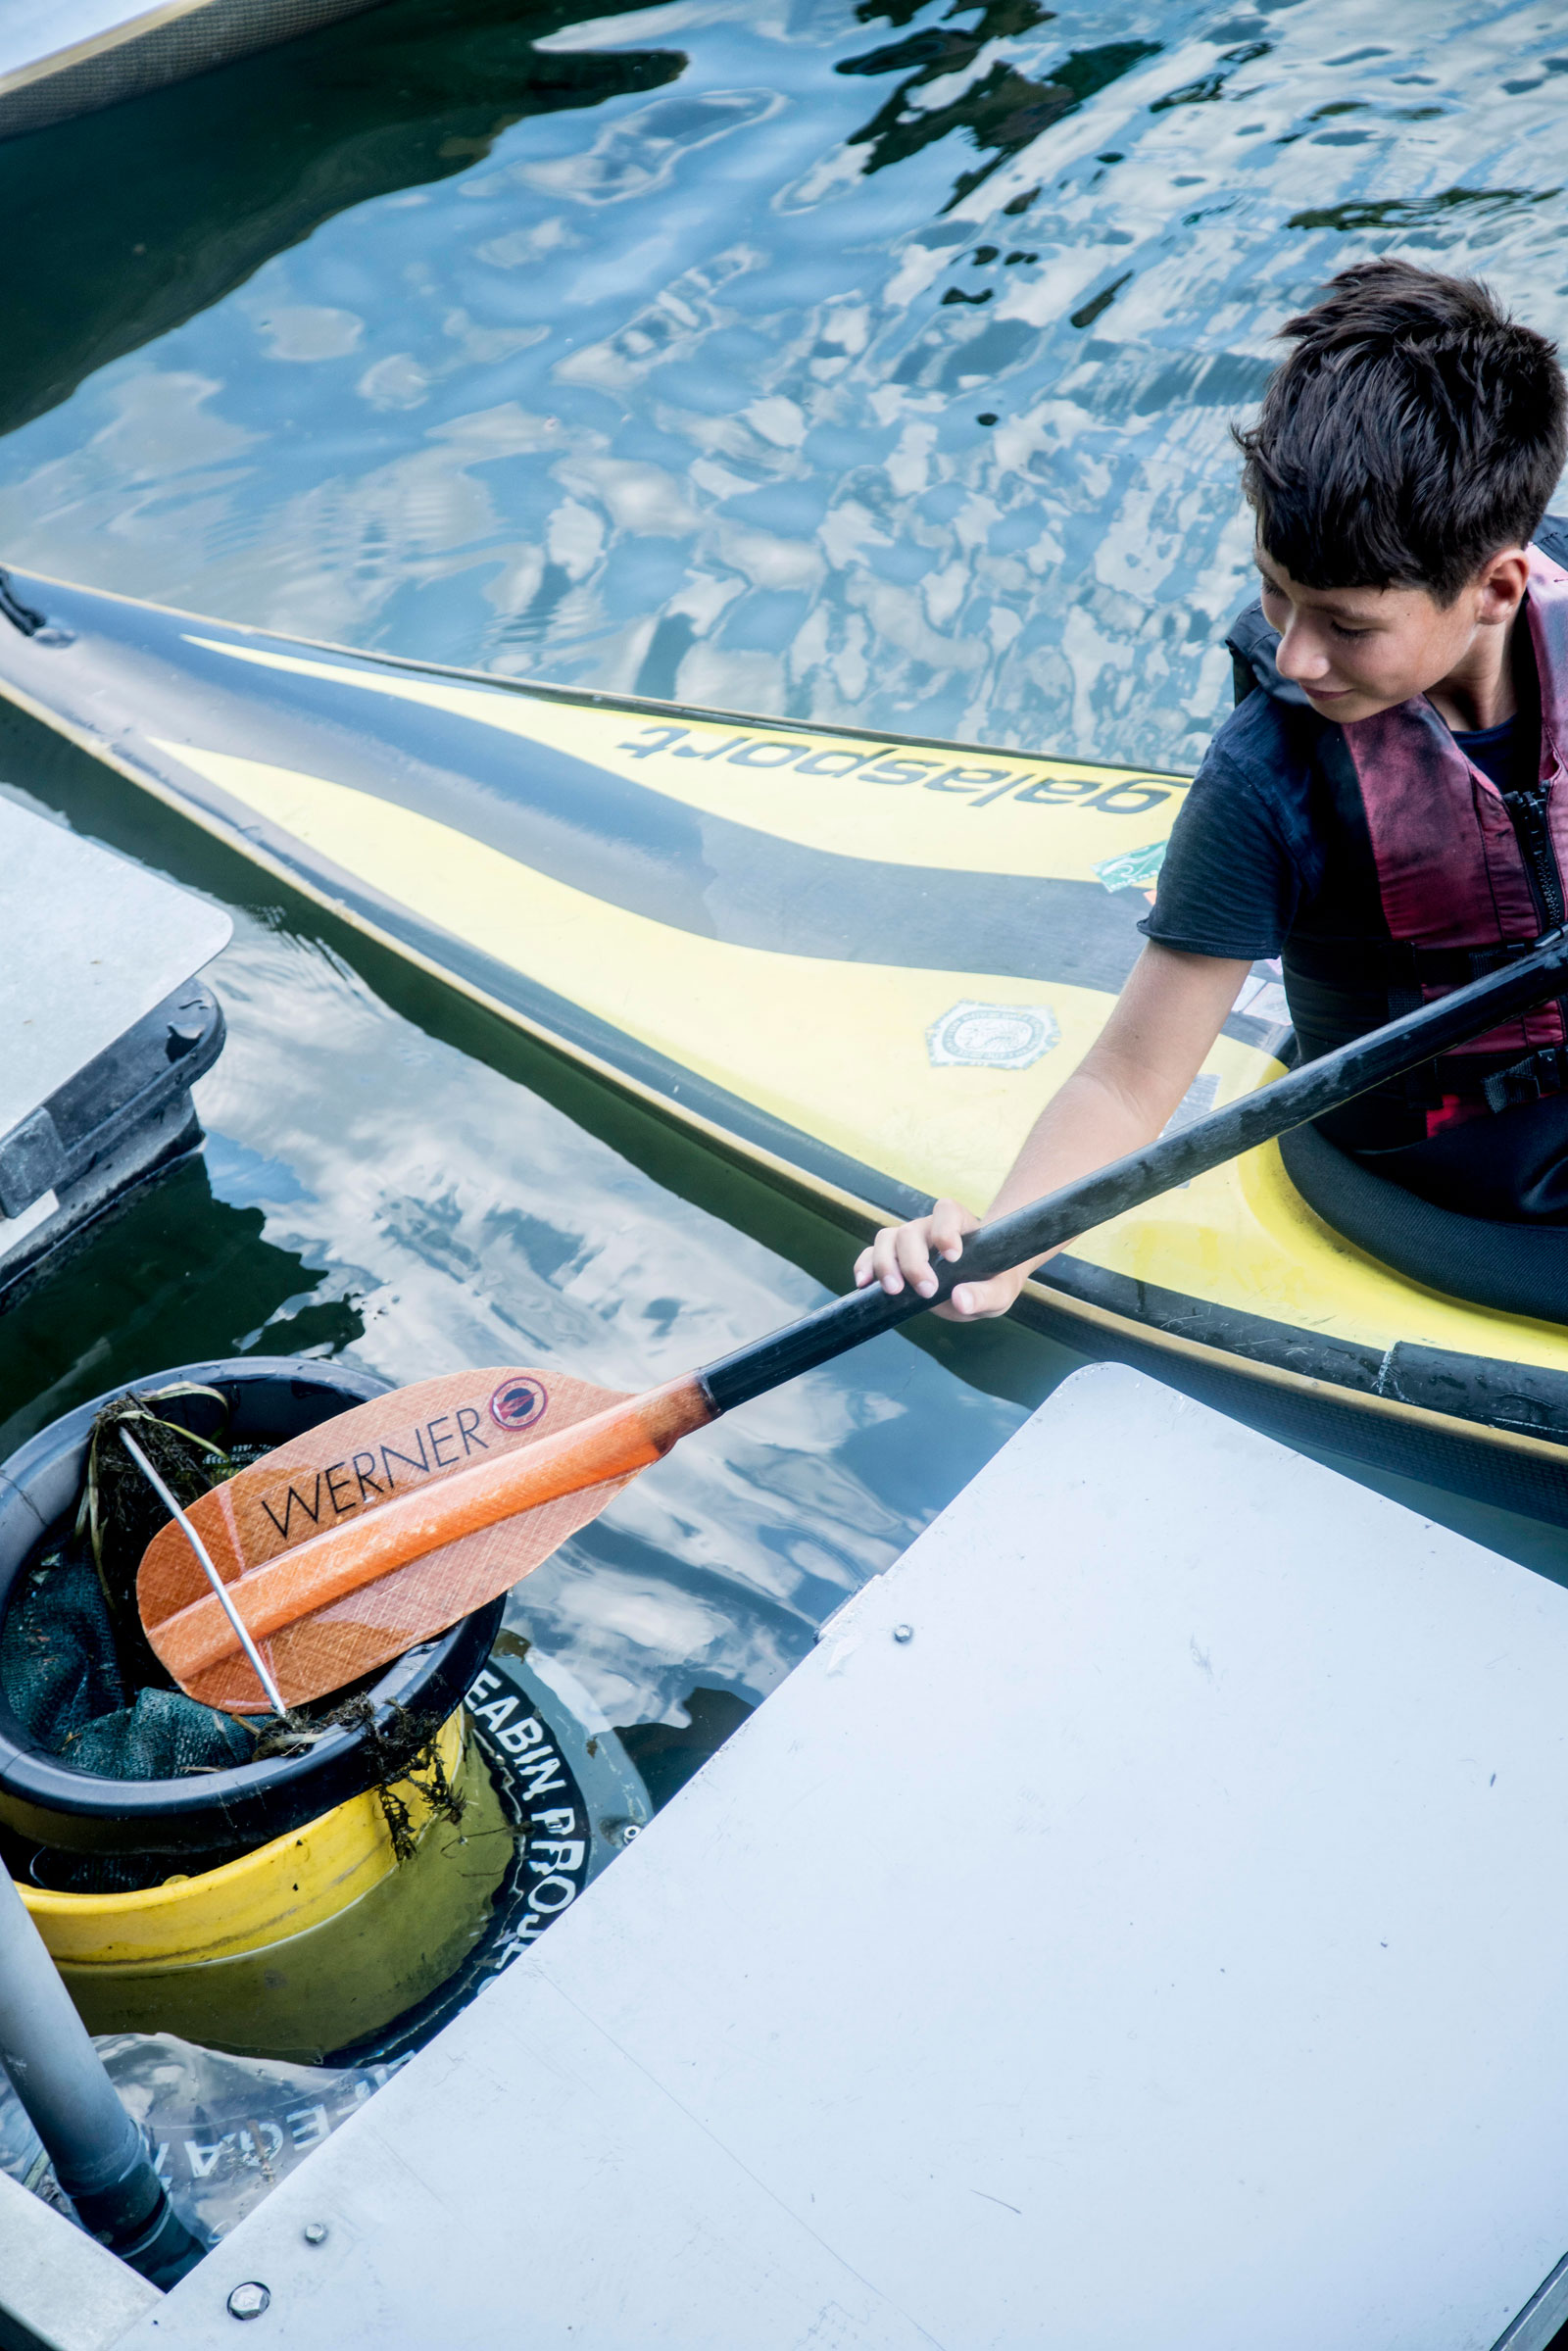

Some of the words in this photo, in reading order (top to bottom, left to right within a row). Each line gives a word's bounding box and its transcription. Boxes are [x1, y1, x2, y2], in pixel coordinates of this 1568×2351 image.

[615, 726, 1190, 815] galasport
[261, 1407, 489, 1540] WERNER
[463, 1668, 566, 1801] EABIN
